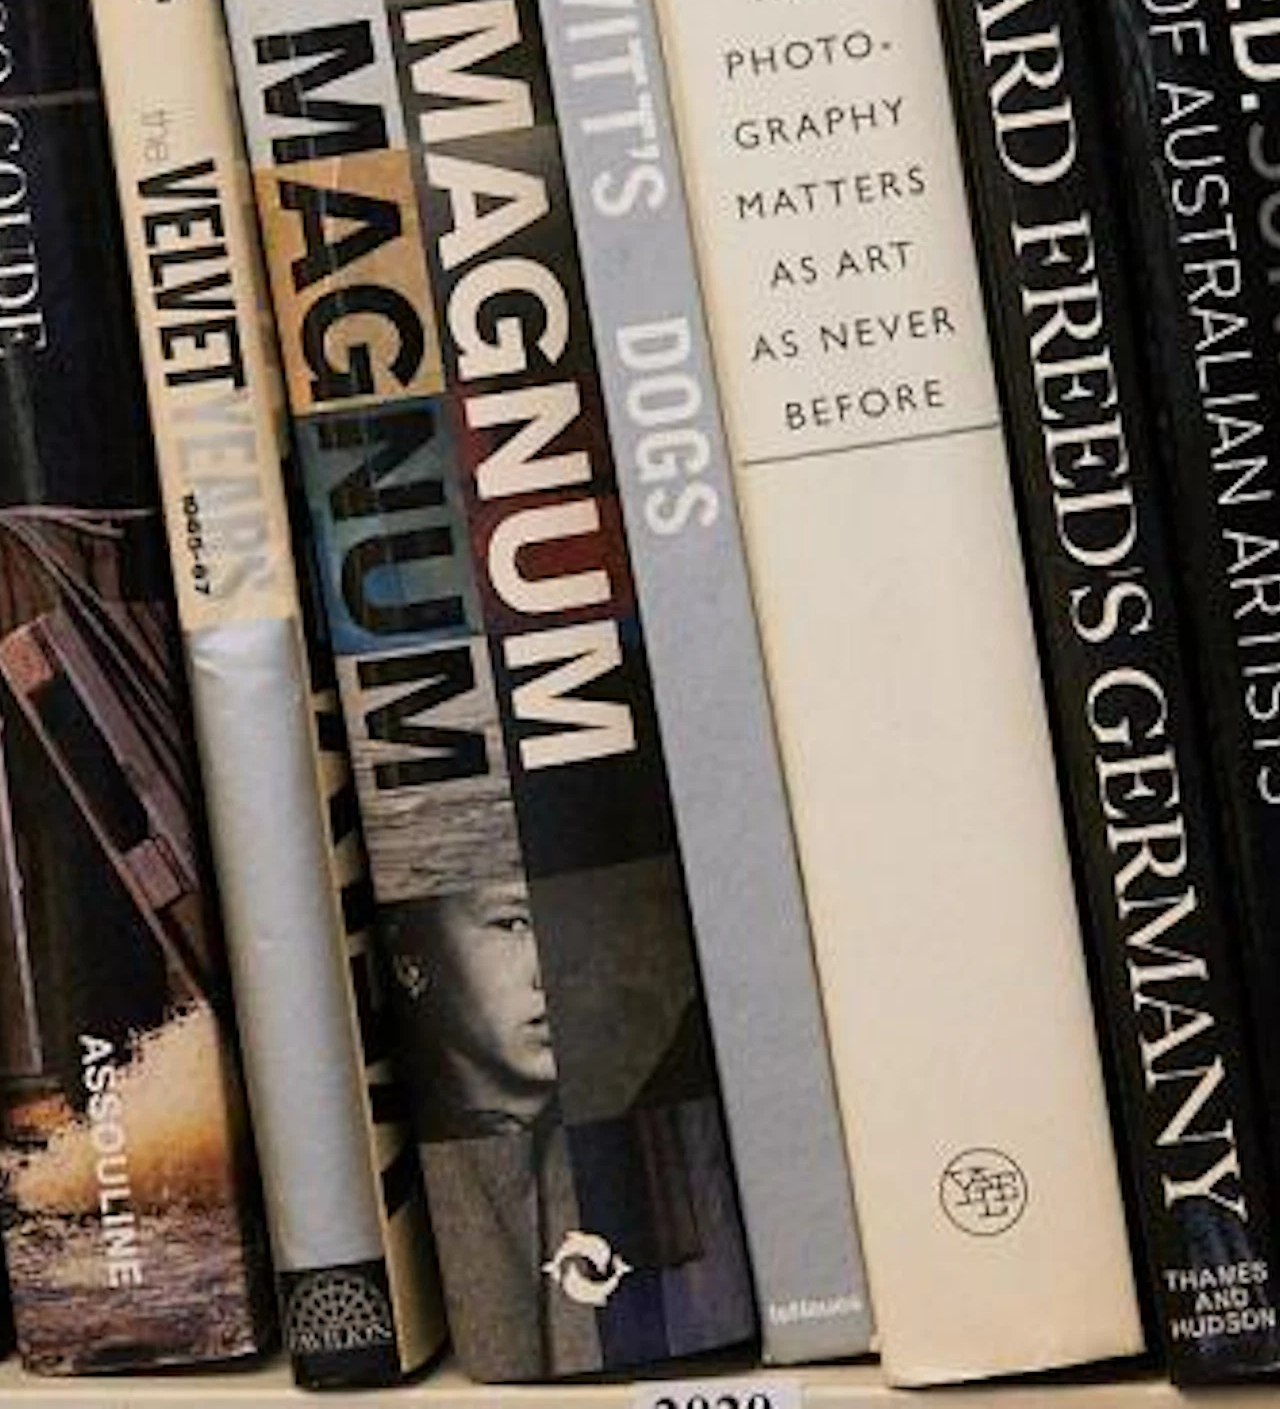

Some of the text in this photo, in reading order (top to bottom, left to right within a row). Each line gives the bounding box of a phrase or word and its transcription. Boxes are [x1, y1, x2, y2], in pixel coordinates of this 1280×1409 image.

[725, 31, 892, 80] PHOTO-
[735, 97, 903, 150] GRAPHY
[737, 166, 926, 222] MATTERS
[138, 159, 247, 390] VELVET
[770, 242, 913, 288] AS ART
[1157, 82, 1271, 505] AUSTRALIAN
[752, 307, 956, 362] AS NEVER
[253, 19, 490, 791] MAGNUM
[616, 315, 720, 537] DOGS
[786, 380, 944, 431] BEFORE
[1009, 213, 1153, 643] FREED'S
[1085, 668, 1248, 1223] GERMANY
[79, 1034, 143, 1288] ASSOULINE
[1165, 1261, 1268, 1291] THAMES
[1194, 1288, 1249, 1312] AND
[1170, 1308, 1276, 1340] HUDSON
